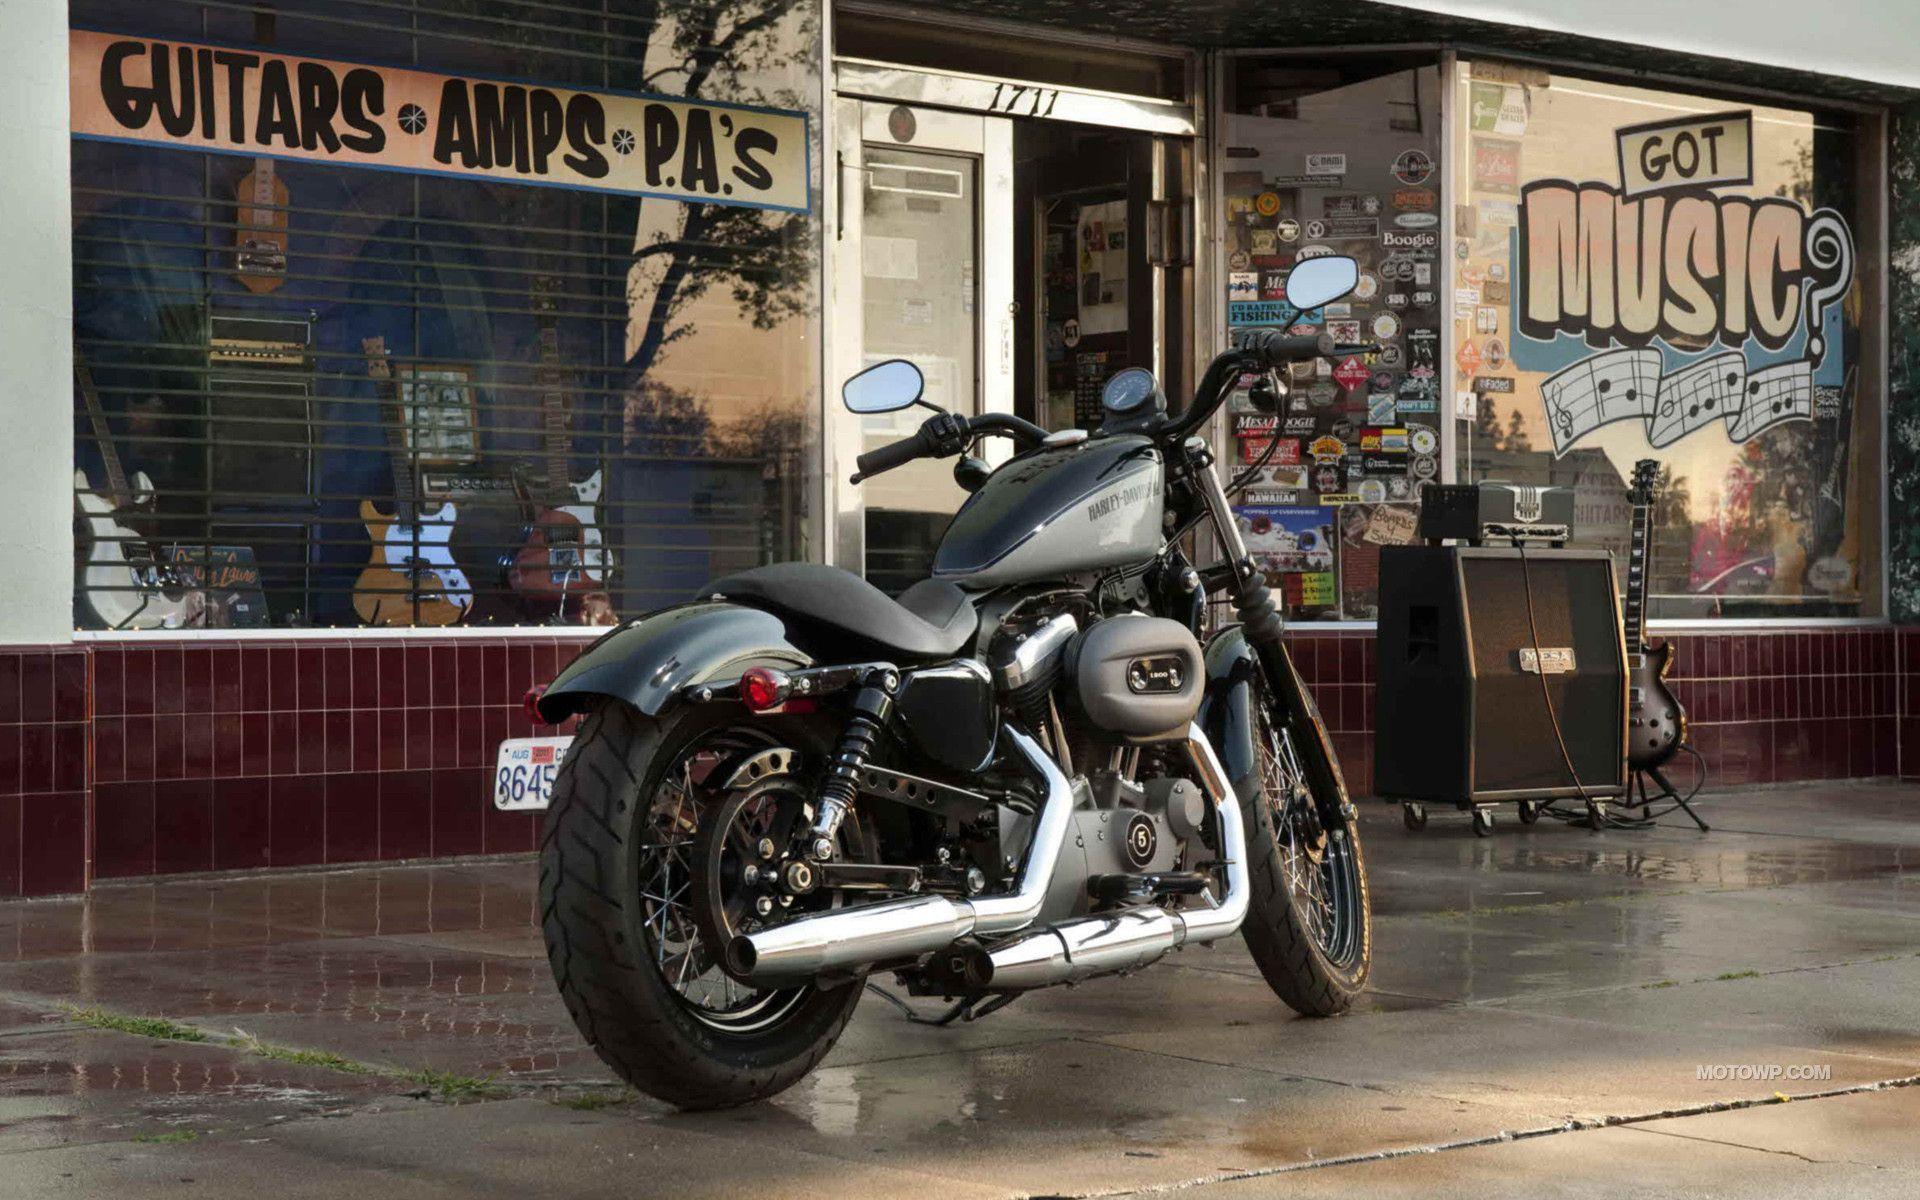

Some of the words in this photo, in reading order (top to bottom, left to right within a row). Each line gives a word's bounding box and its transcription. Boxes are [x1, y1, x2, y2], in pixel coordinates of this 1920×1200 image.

[987, 83, 1058, 117] 1711
[101, 41, 385, 153] GUITARS
[434, 79, 608, 178] AMPS
[1639, 127, 1725, 182] GOT
[1383, 232, 1435, 247] Boogie
[1231, 311, 1291, 321] FISHING
[1247, 493, 1297, 503] HAWAIIAN
[512, 750, 530, 759] AUG
[1137, 830, 1147, 848] 5
